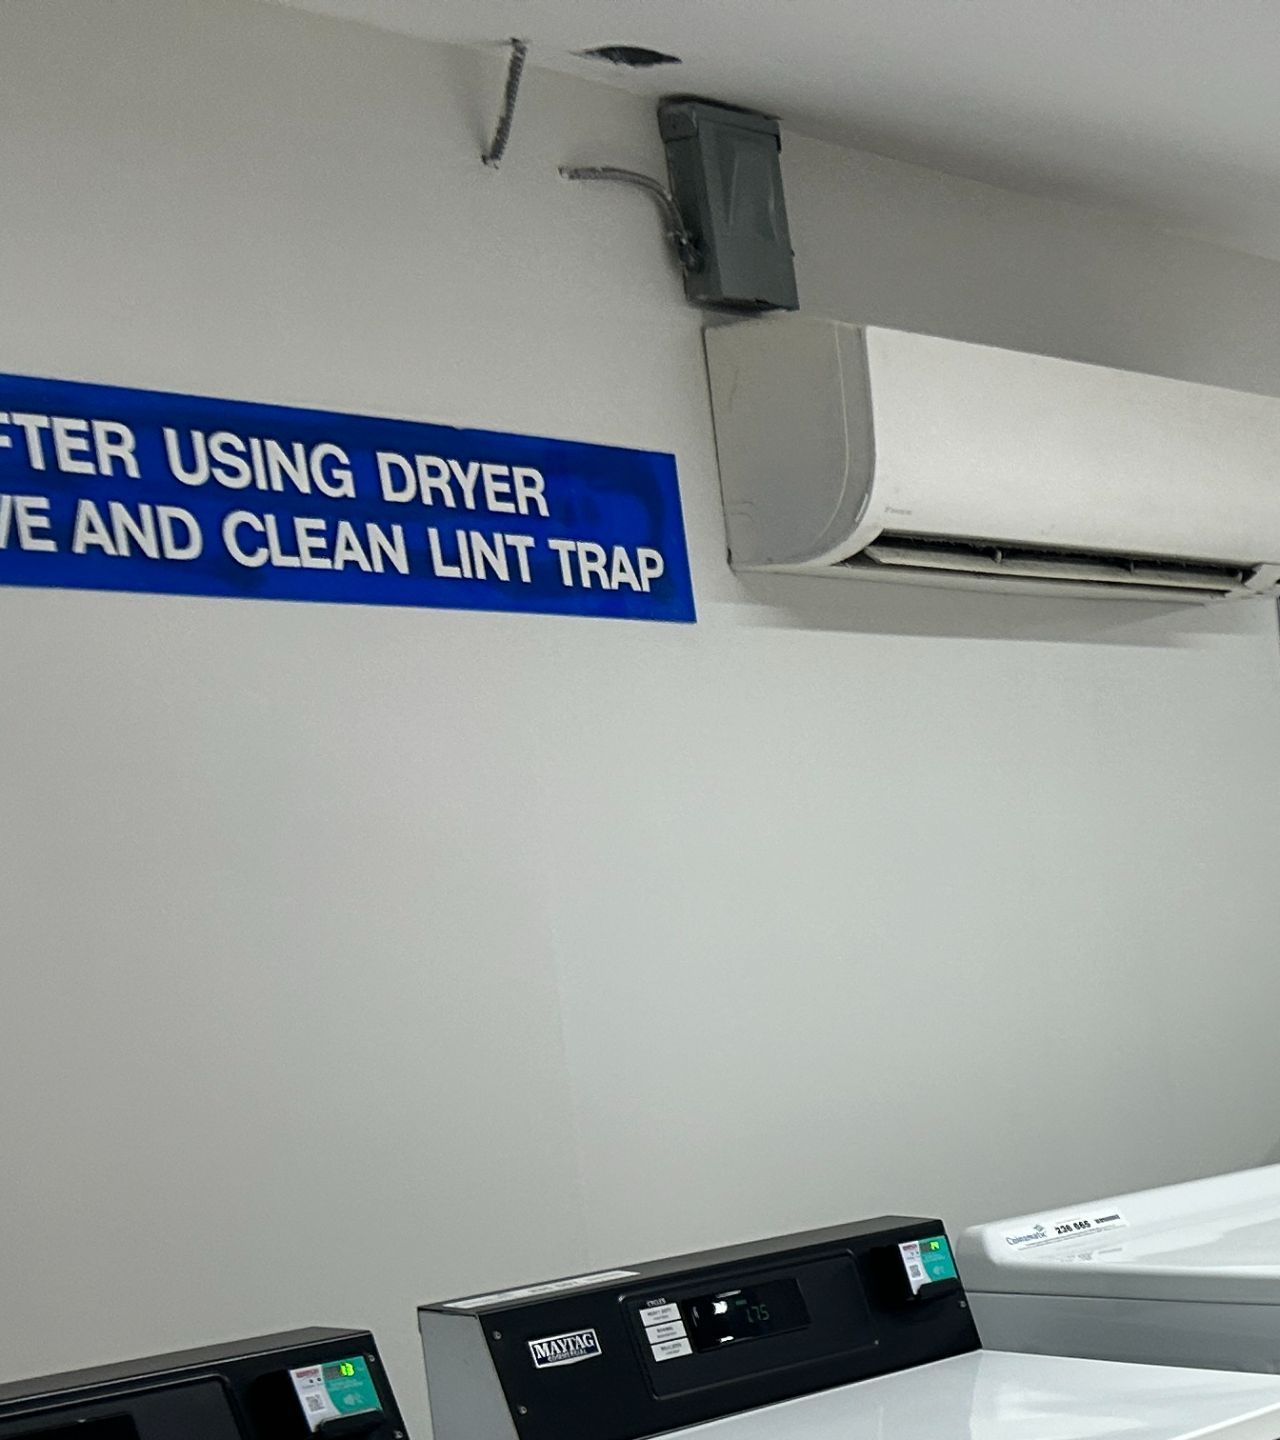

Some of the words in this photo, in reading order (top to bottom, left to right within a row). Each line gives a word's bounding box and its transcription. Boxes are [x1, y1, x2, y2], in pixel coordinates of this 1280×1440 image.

[0, 411, 140, 478] TER
[163, 427, 356, 498] USING
[377, 451, 549, 517] DRYER
[73, 500, 202, 560] AND
[222, 510, 409, 575] CLEAN
[428, 527, 534, 583] LINT
[548, 539, 665, 592] TRAP
[533, 1333, 595, 1359] MAYTAG
